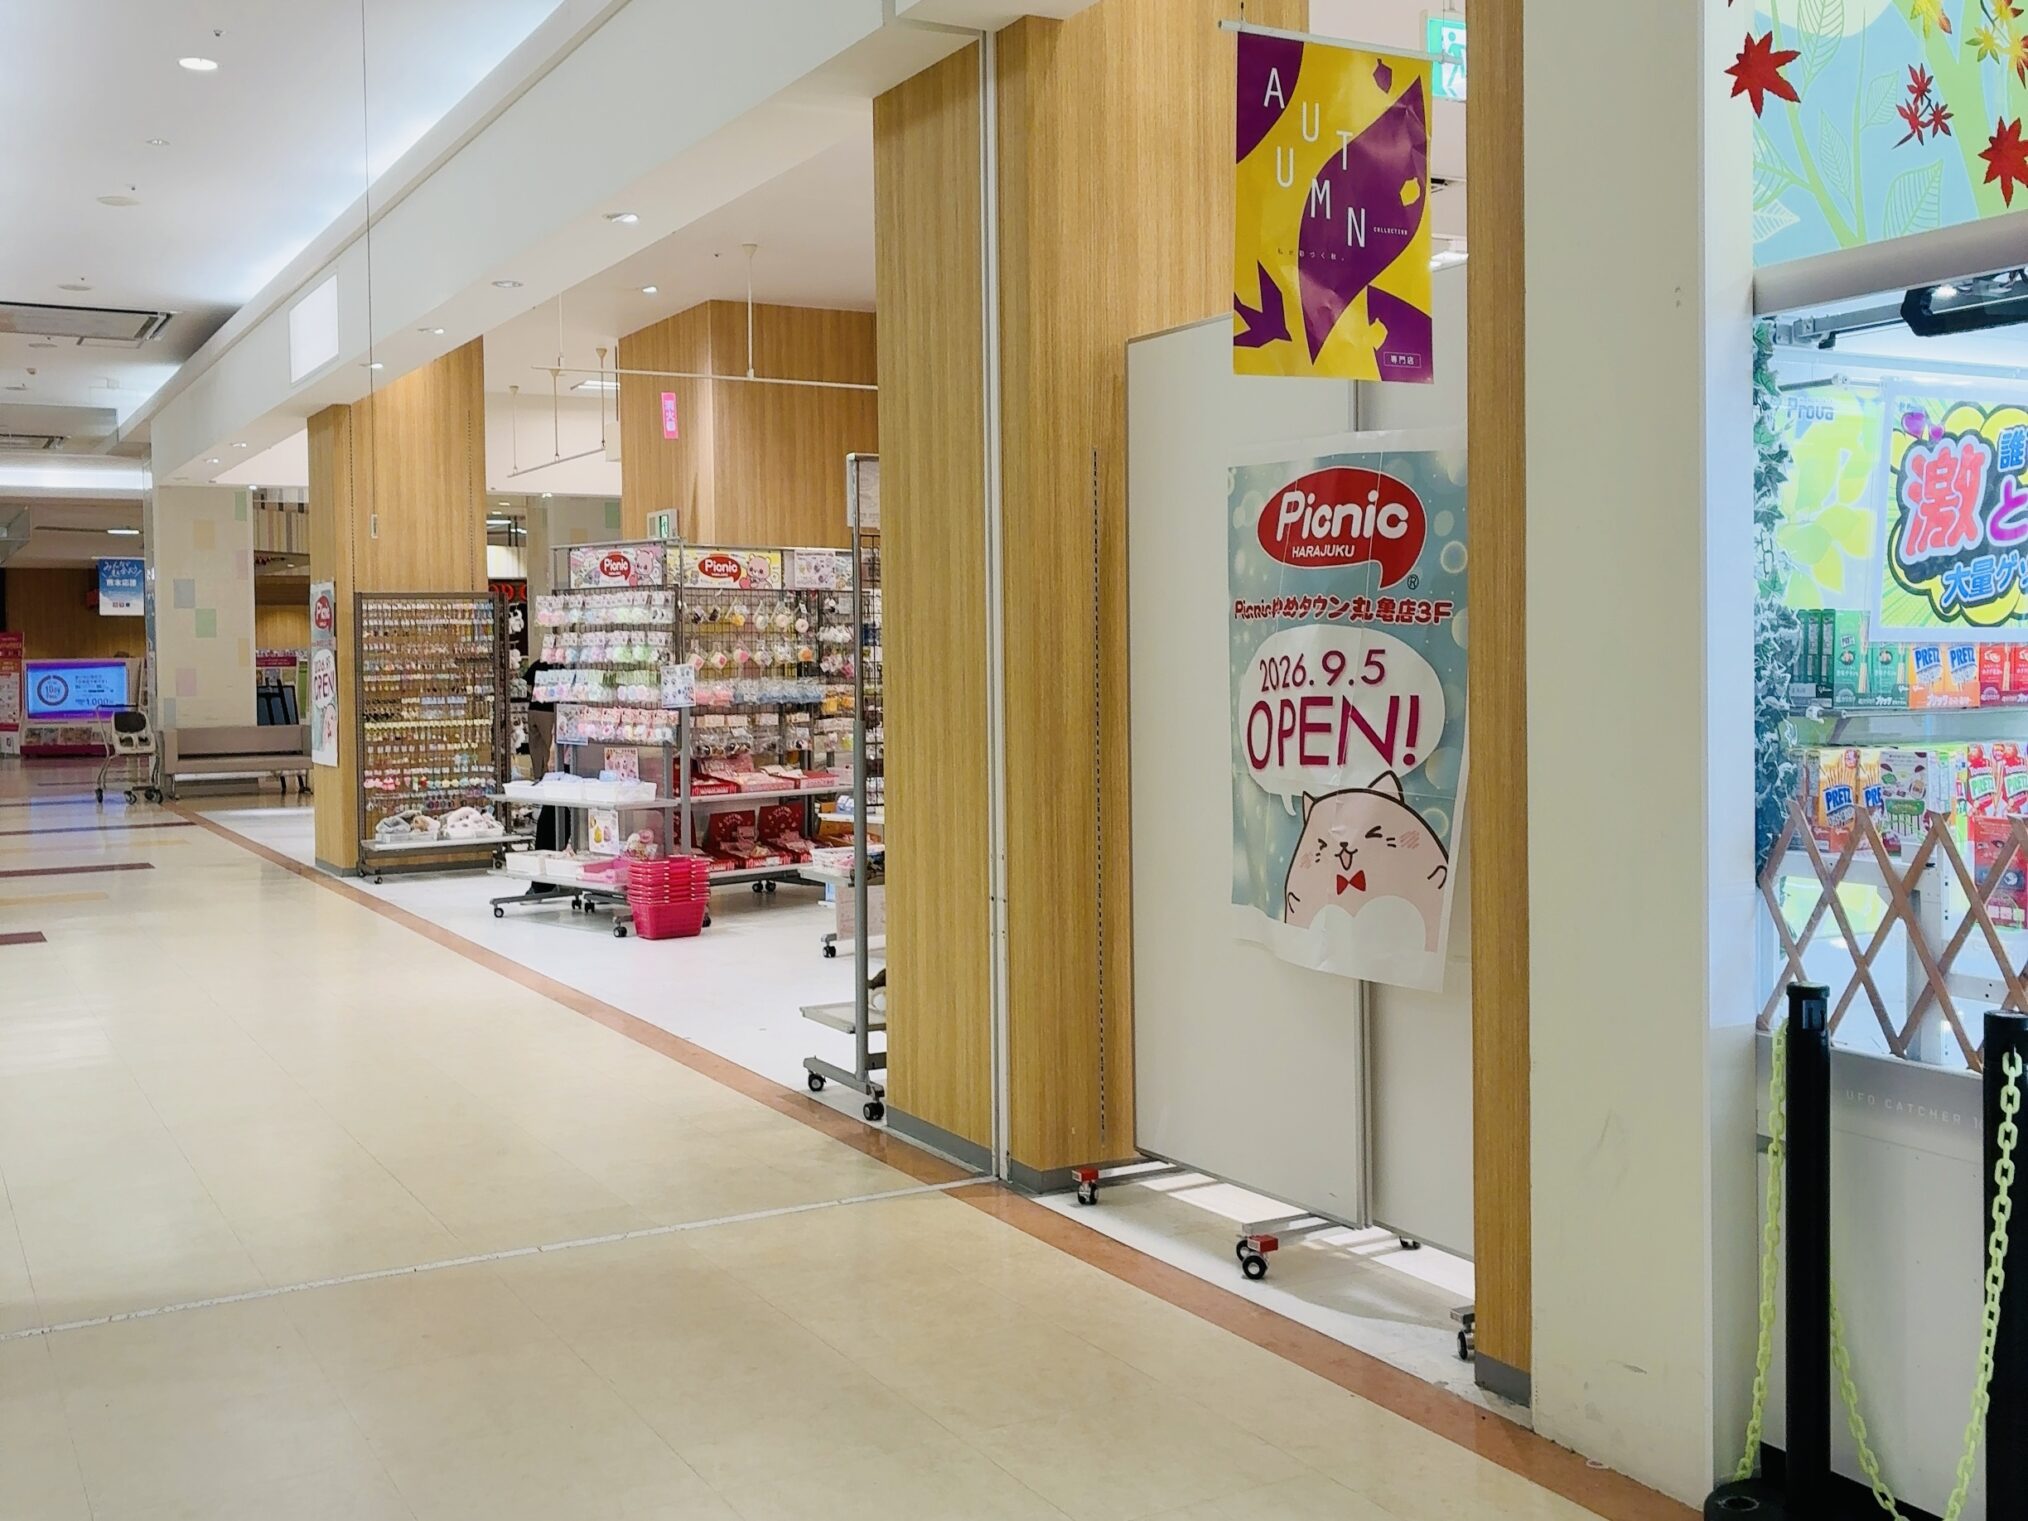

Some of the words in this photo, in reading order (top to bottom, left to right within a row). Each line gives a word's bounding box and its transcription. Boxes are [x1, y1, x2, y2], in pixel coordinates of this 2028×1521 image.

[1390, 354, 1415, 366] 専門店
[1786, 396, 1834, 421] Prova
[1276, 489, 1409, 543] Picnic
[1291, 543, 1356, 559] HARAJUKU
[603, 557, 629, 572] Picnic
[704, 558, 738, 573] Picnic
[1914, 647, 1940, 669] PRETZ
[1949, 647, 1975, 670] PRETZ
[1259, 648, 1386, 693] 2026.9.5
[1246, 694, 1420, 770] OPEN!
[1825, 787, 1852, 811] PRETZ
[1846, 1090, 1875, 1106] UFO
[1884, 1098, 1962, 1126] CATCHER
